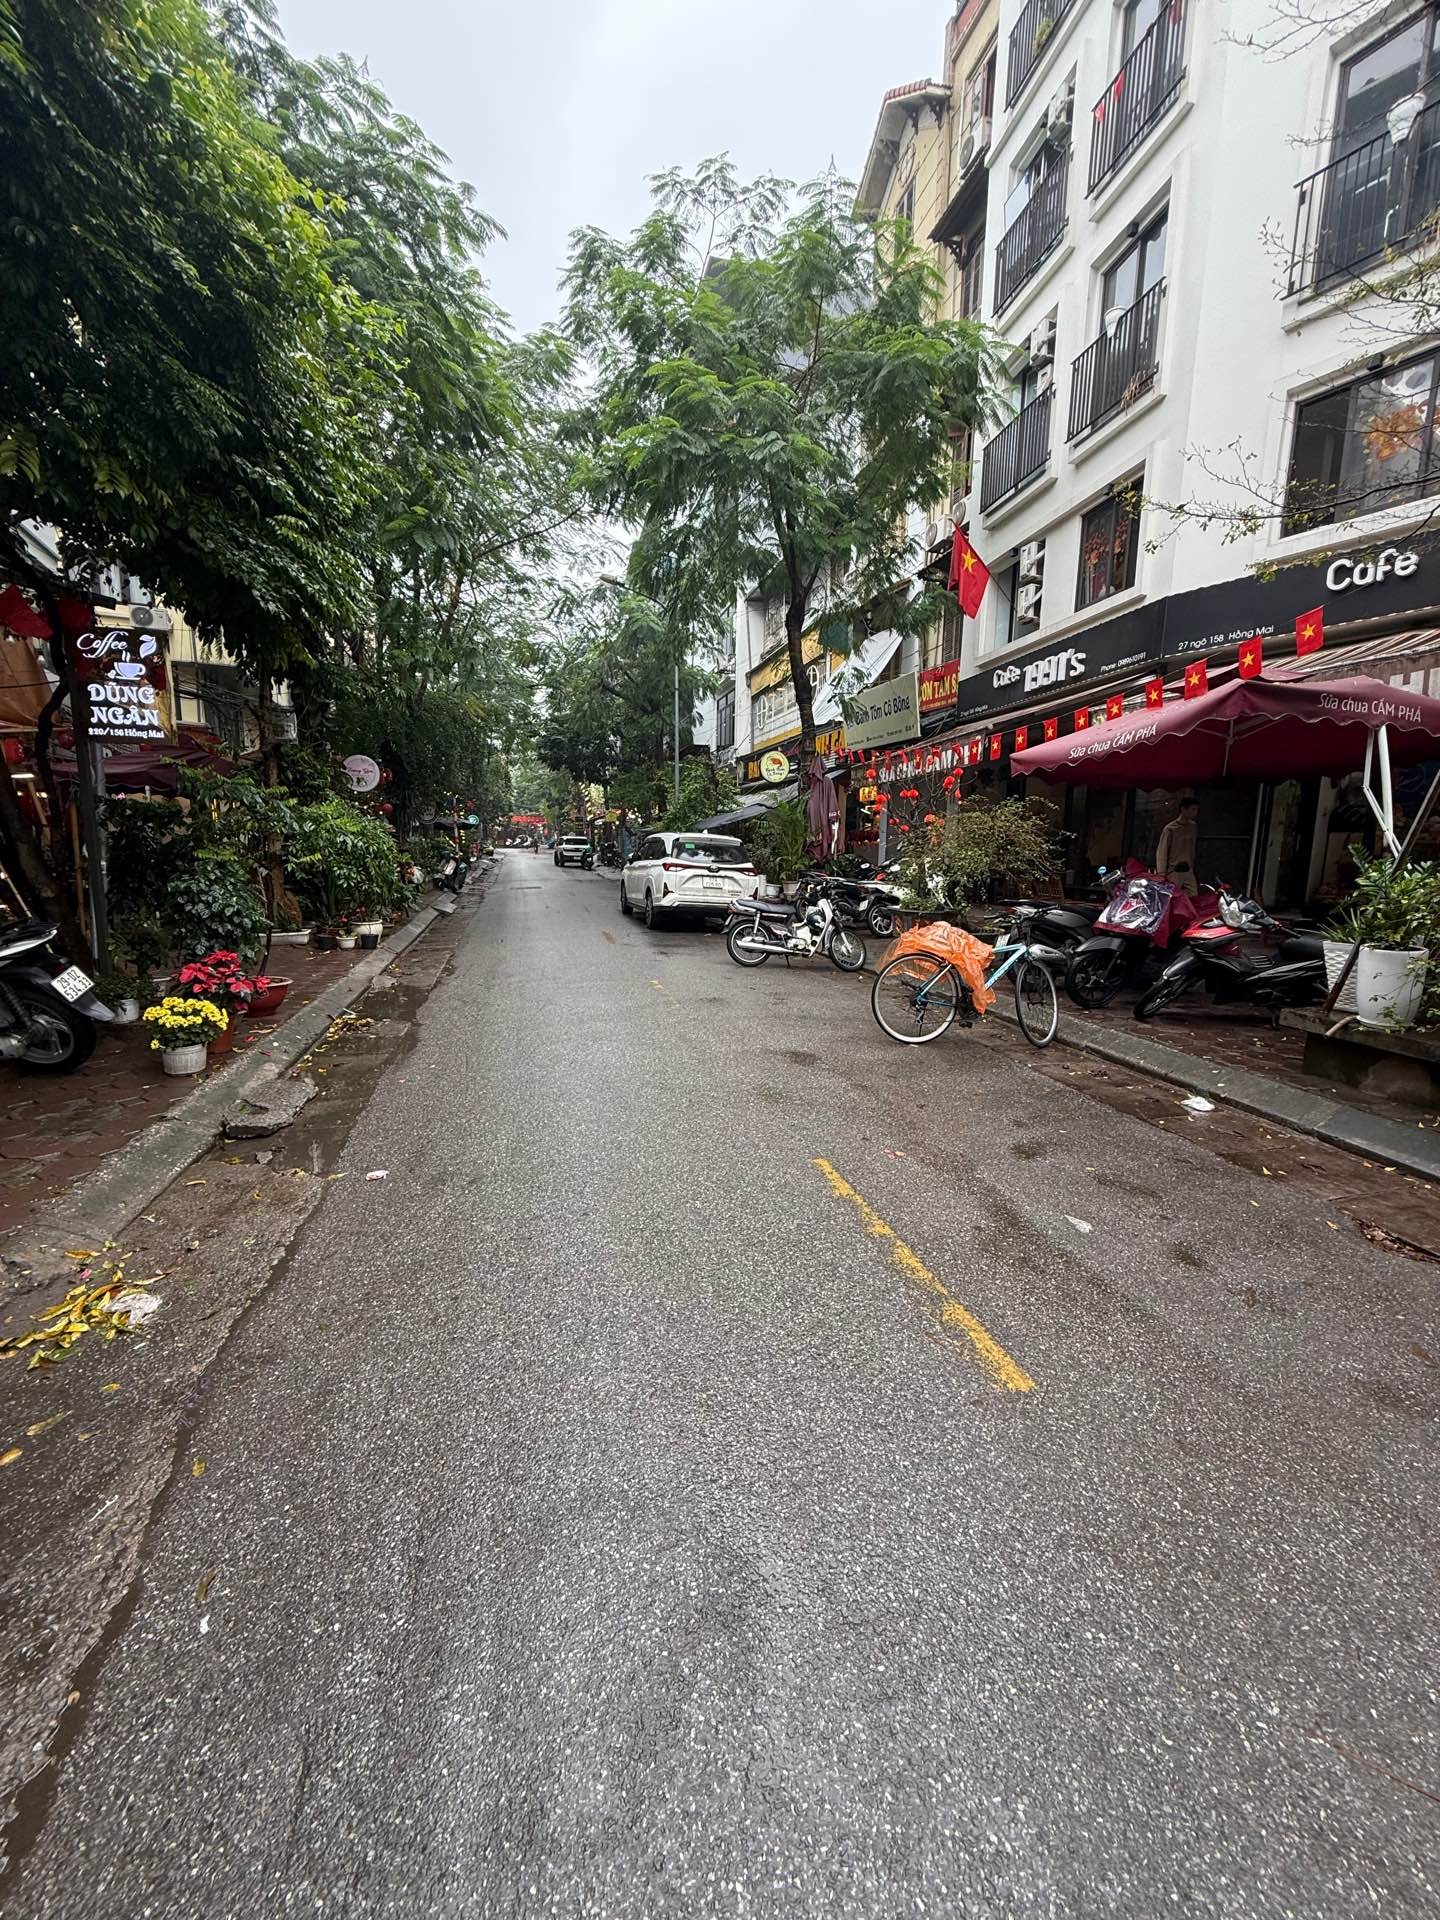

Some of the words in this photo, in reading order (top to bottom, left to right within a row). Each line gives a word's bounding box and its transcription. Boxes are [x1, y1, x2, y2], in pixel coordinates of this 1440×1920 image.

[1326, 548, 1419, 591] Cafe
[77, 631, 129, 658] Coffee
[1178, 642, 1188, 650] 27
[1210, 634, 1224, 644] 158
[993, 665, 1021, 688] Cafe
[87, 681, 156, 705] DŨNG
[90, 705, 159, 727] NGÂN
[1341, 697, 1369, 713] chua
[1087, 740, 1111, 755] chua
